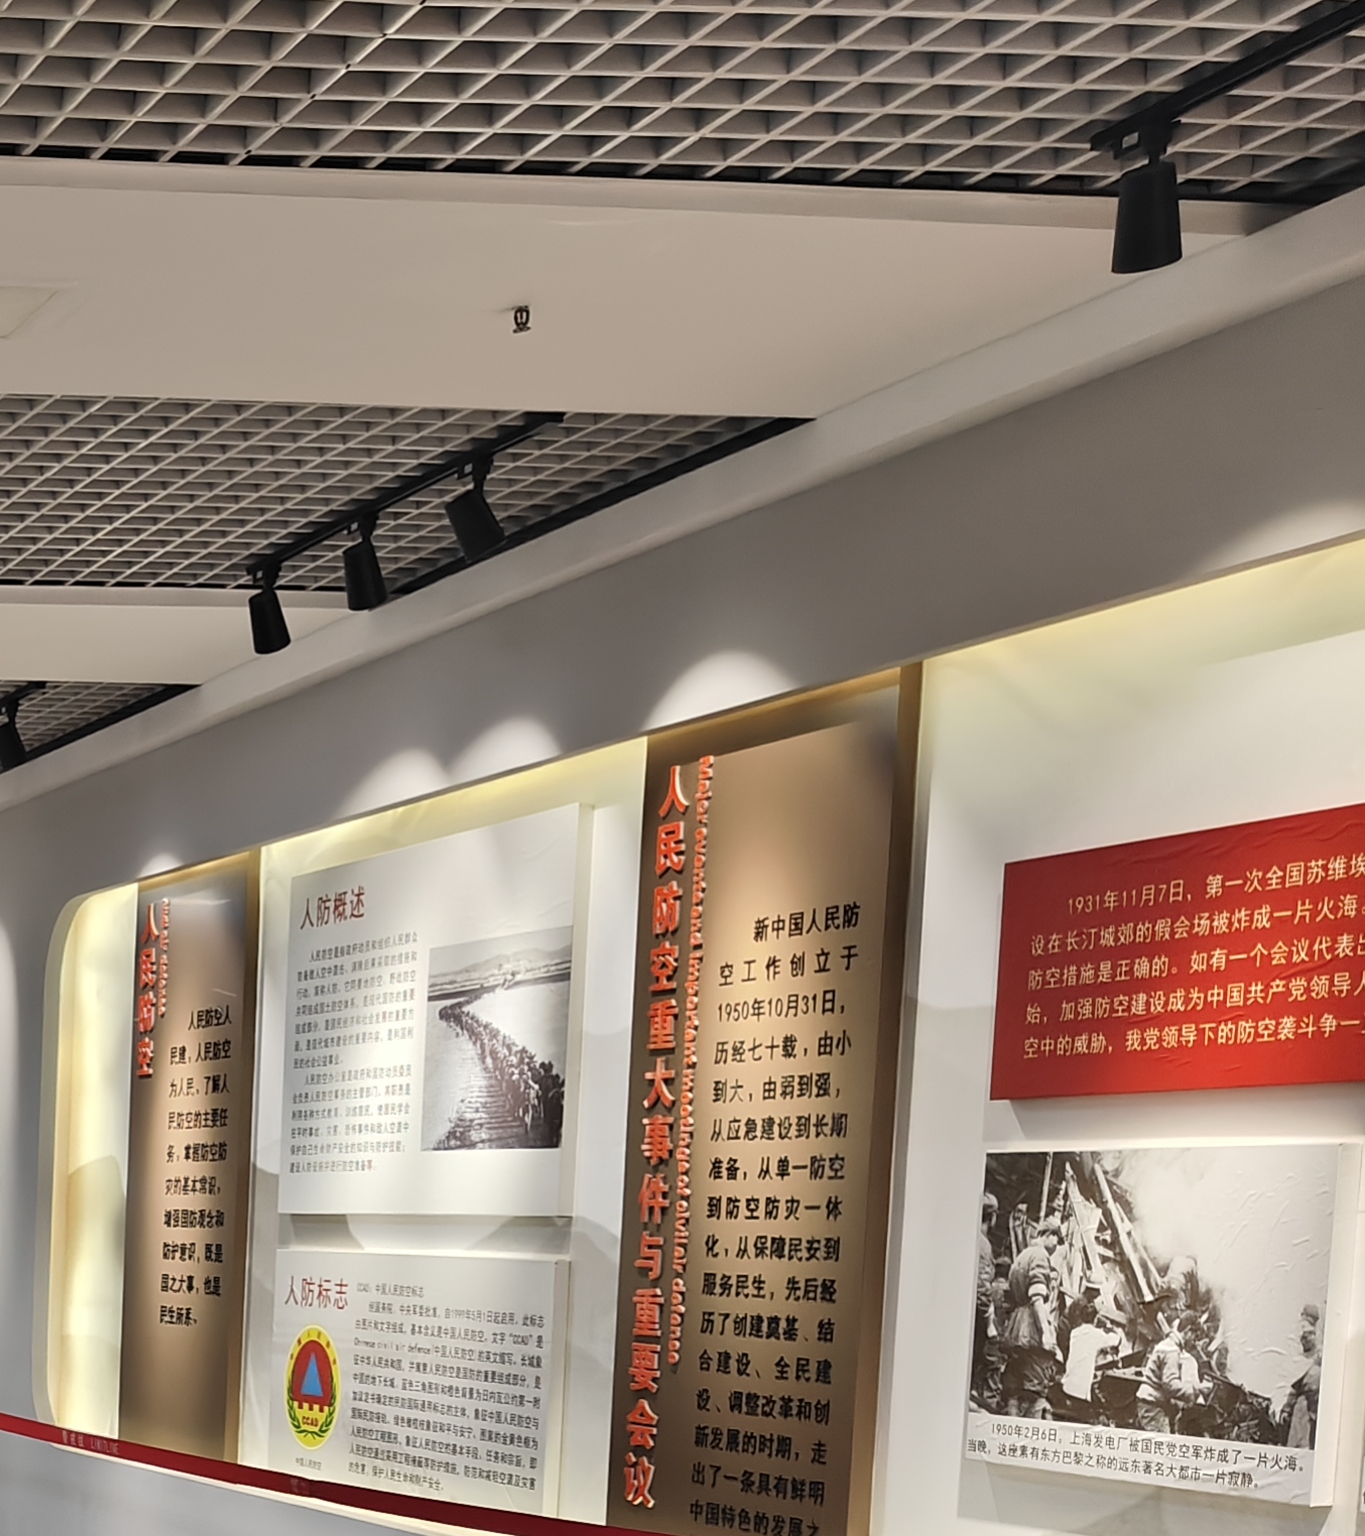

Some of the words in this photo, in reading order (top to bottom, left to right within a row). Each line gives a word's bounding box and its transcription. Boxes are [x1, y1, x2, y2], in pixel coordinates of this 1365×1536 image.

[696, 754, 714, 823] Major
[299, 885, 365, 930] 人防概述
[753, 901, 860, 942] 新中国人民防
[689, 905, 703, 948] and
[719, 945, 858, 986] 空工作创立于
[136, 903, 160, 1077] 人民防空
[718, 989, 845, 1022] 1950年10月31日，
[188, 1005, 232, 1031] 人民防空人
[714, 1030, 852, 1064] 历经七十载，由小
[1023, 1011, 1365, 1060] 空中的威胁，我党领导下的防空袭斗争一
[170, 1040, 231, 1065] 民建，人民防空
[712, 1072, 840, 1103] 到大，由弱到强，
[168, 1108, 228, 1130] 民防空的主要任
[711, 1112, 848, 1142] 从应急建设到长期
[624, 765, 689, 1509] 人民防空重大事件与重要会议
[709, 1153, 845, 1180] 准备，从单一防空
[676, 1174, 691, 1197] of
[163, 1209, 224, 1229] 增强国防观念和
[706, 1195, 842, 1221] 到防空防灾一体
[672, 1246, 687, 1273] air
[705, 1234, 840, 1261] 化，从保障民安到
[284, 1275, 348, 1310] 人防标志
[702, 1273, 837, 1303] 服务民生，先后经
[700, 1311, 835, 1343] 历了创建奠基、结
[698, 1349, 832, 1384] 合建设、全民建
[696, 1388, 830, 1426] 设、调整改革和创
[694, 1424, 827, 1465] 新发展的时期，走
[691, 1461, 825, 1507] 出了一条具有鲜明
